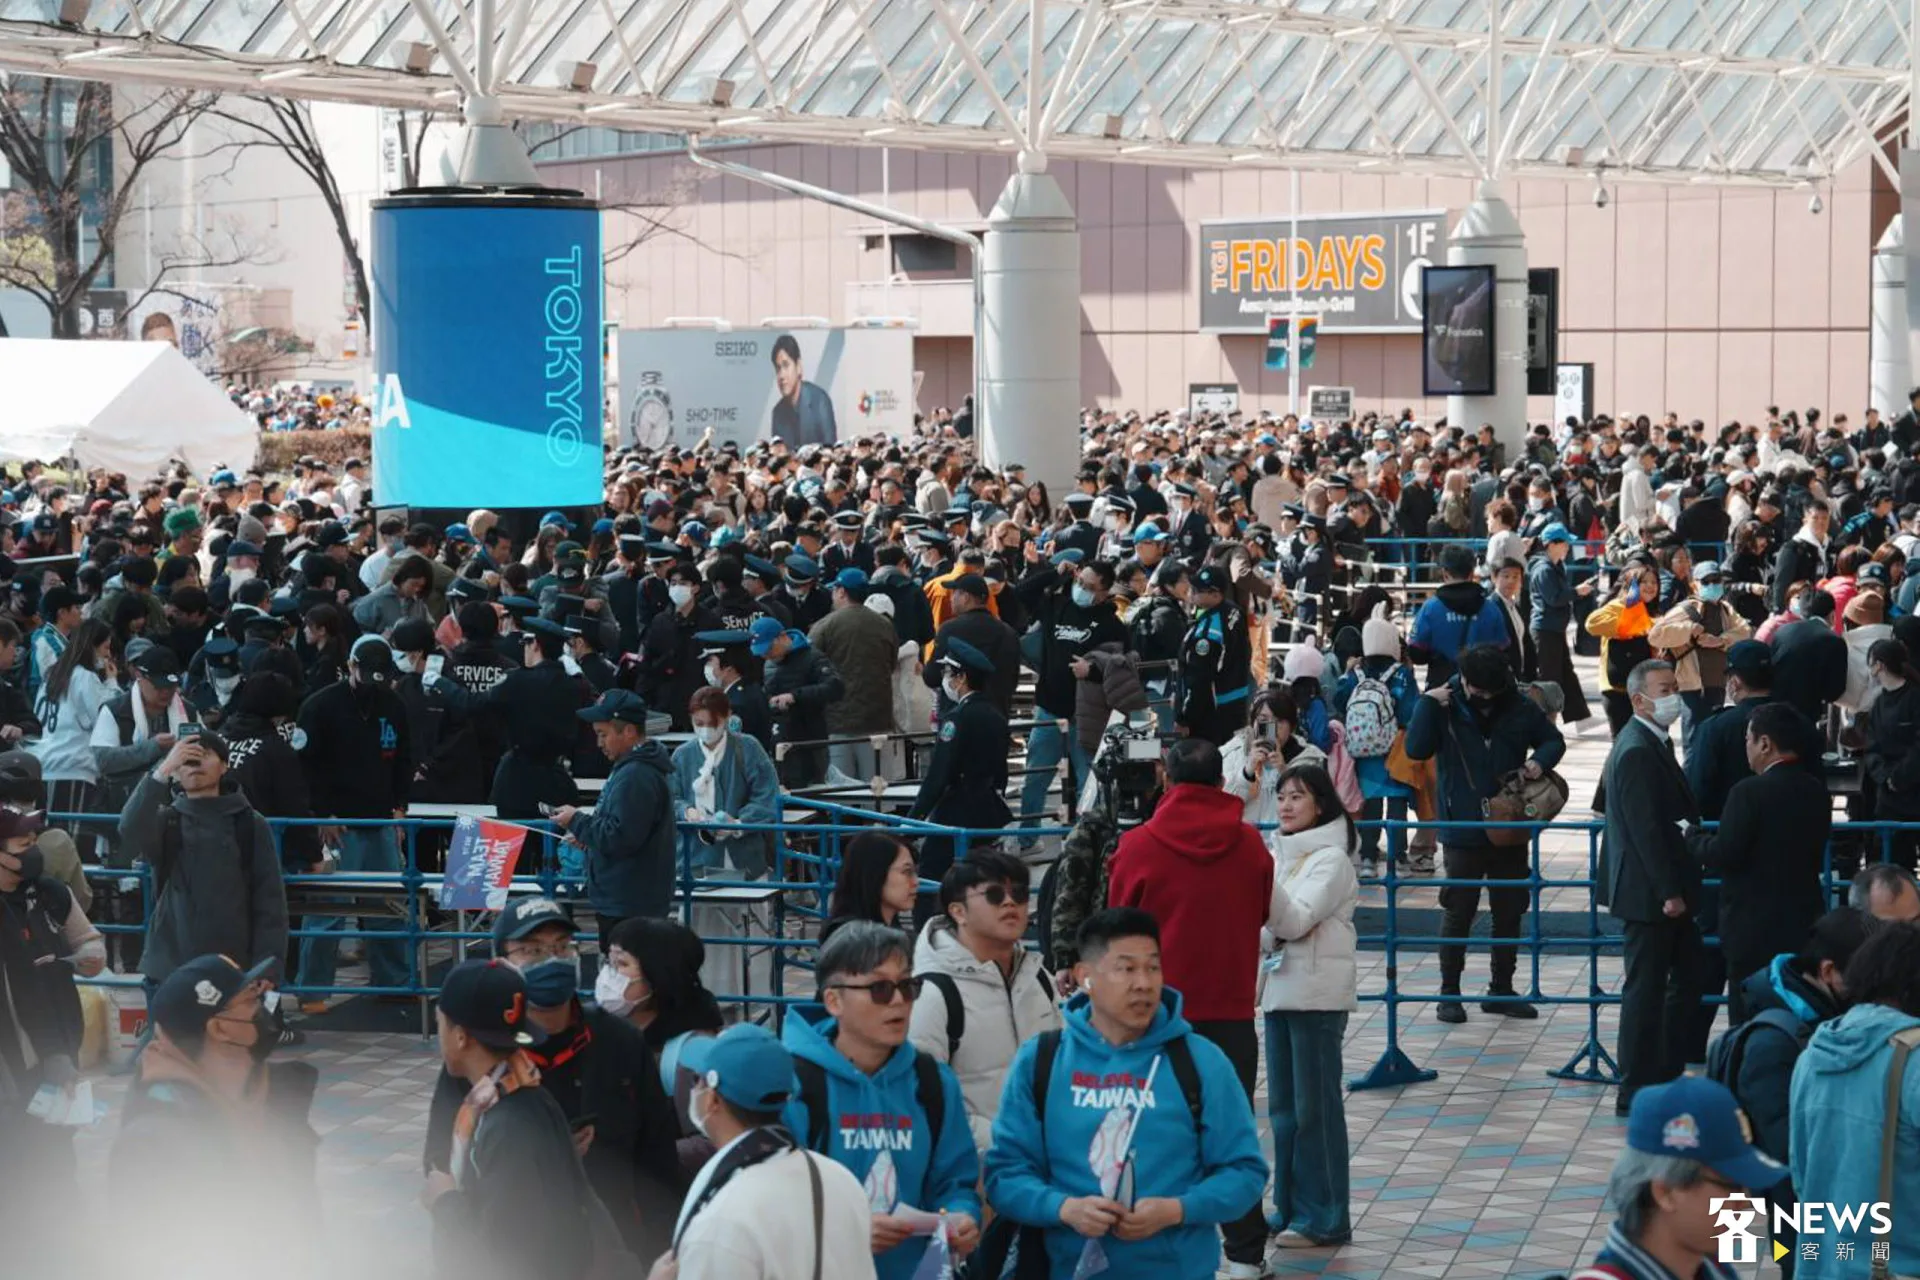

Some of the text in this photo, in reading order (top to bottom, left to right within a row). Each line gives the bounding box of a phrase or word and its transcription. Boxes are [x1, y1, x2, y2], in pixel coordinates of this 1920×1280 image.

[1407, 222, 1437, 255] 1F
[1211, 235, 1386, 294] TGI FRIDAYS
[544, 245, 583, 468] TOKYO
[714, 341, 758, 356] SEIKO
[453, 665, 503, 682] ERVICE
[1069, 1085, 1156, 1108] TAIWAN
[839, 1129, 913, 1151] TAIWAN
